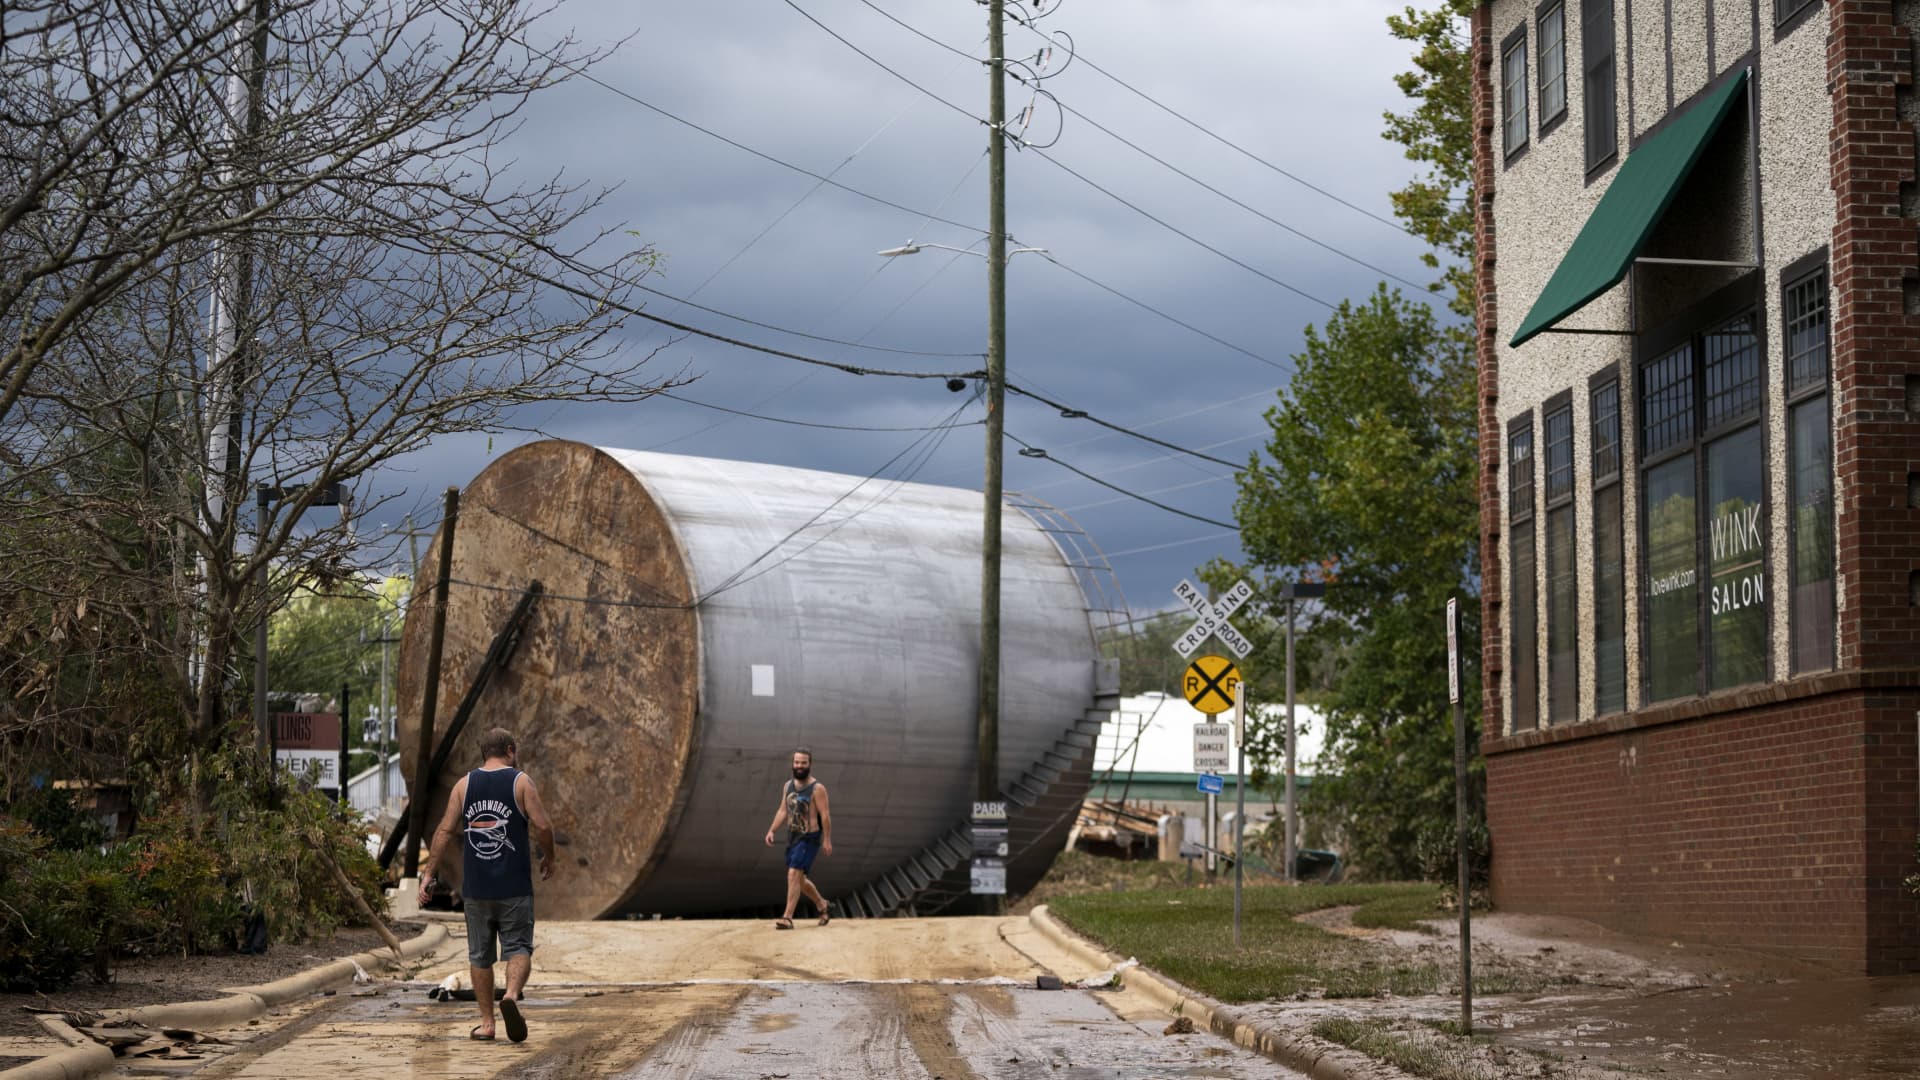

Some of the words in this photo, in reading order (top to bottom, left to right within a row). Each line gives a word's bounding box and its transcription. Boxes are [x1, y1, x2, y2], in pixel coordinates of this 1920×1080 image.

[1710, 503, 1762, 561] WINK
[1711, 572, 1764, 615] SALON
[1176, 583, 1206, 616] RAIL
[1217, 623, 1249, 655] ROAD
[1178, 584, 1249, 655] CROSSING
[1186, 676, 1199, 692] R
[1195, 727, 1227, 737] RAILROAD
[1198, 743, 1224, 752] DANGER
[1195, 758, 1228, 767] CROSSING
[465, 799, 512, 819] MOTORWORKS
[973, 802, 1007, 819] PARK
